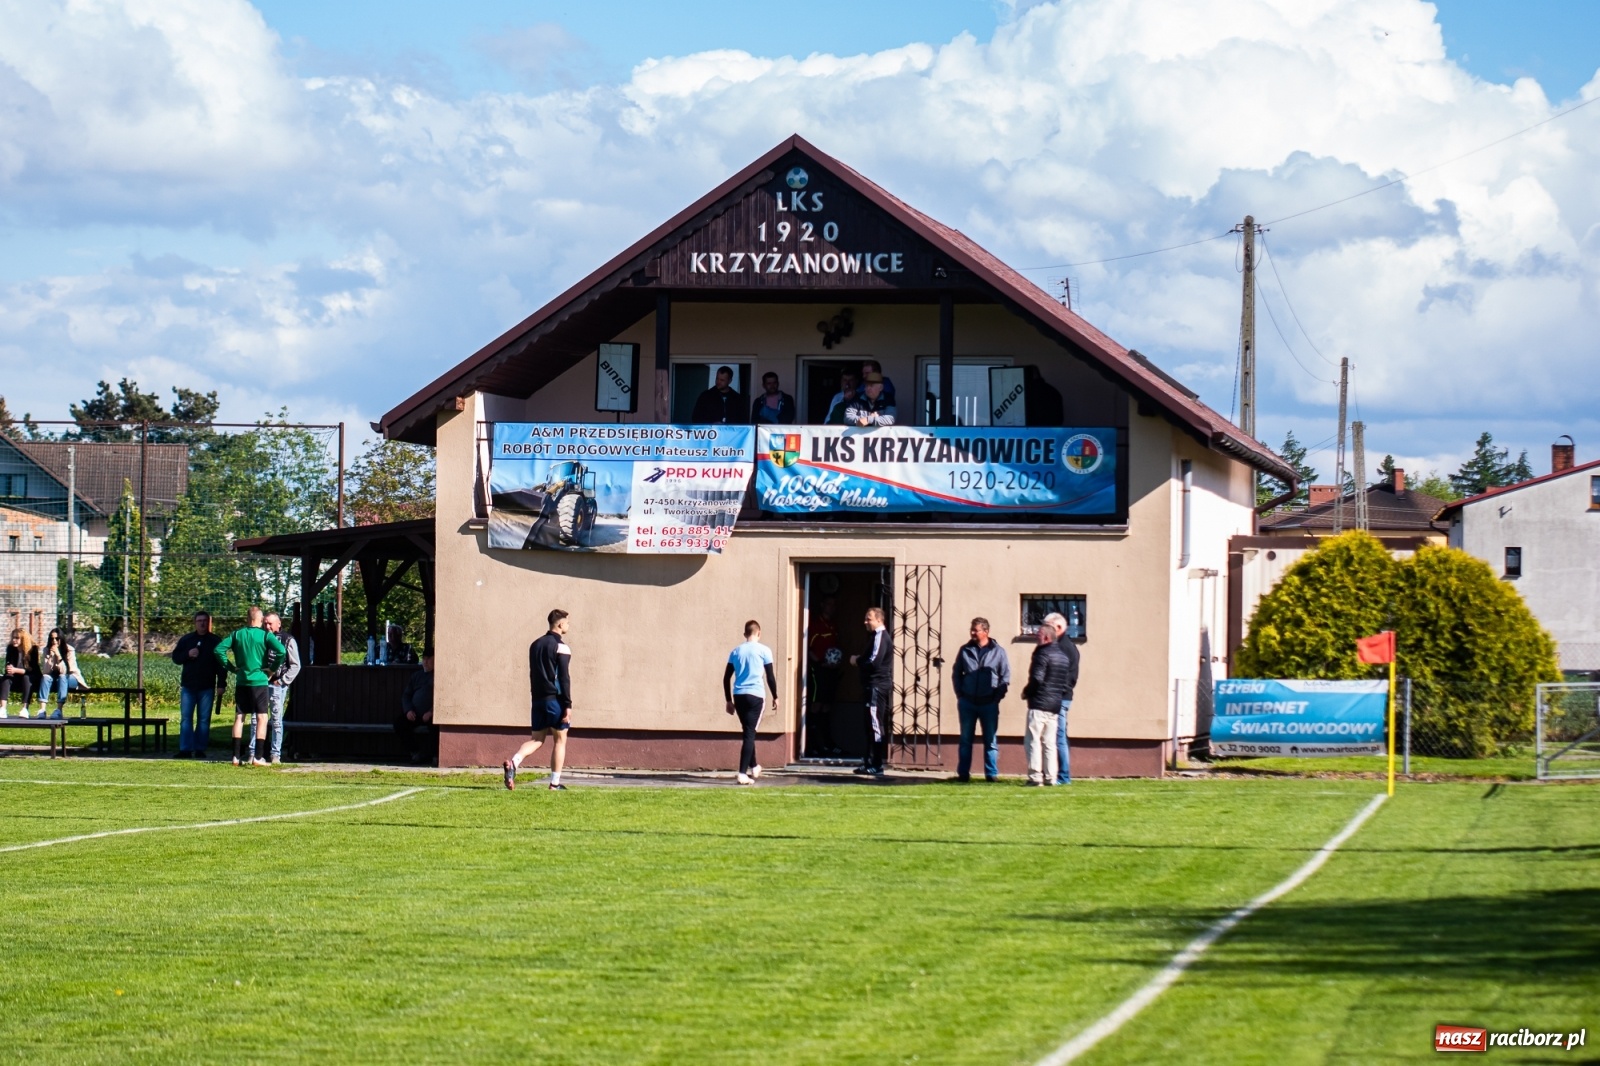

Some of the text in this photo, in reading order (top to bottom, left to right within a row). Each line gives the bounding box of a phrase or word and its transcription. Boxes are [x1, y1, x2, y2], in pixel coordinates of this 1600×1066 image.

[776, 191, 824, 212] LKS
[757, 221, 839, 243] 1920
[690, 247, 904, 274] KRZYŻANOWICE
[600, 360, 632, 394] BINGO
[993, 384, 1024, 420] BINGO
[531, 427, 717, 441] A&M PRZEDSIĘBIORSTWO
[503, 441, 552, 454] ROBÓT
[557, 444, 651, 455] DROGOWYCH
[655, 446, 708, 457] Mateusz
[811, 432, 1056, 464] LKS KRZYŻANOWICE
[666, 467, 744, 478] PRD KUHN
[948, 470, 1056, 490] 1920-2020
[643, 498, 675, 506] 47-450
[763, 486, 889, 512] Naszego Klubu
[637, 526, 733, 536] tel. 603 885 41
[635, 538, 655, 548] tel.
[660, 538, 682, 548] 663
[686, 538, 709, 548] 933
[1218, 683, 1266, 695] SZYBKI
[1225, 701, 1309, 715] INTERNET
[1230, 719, 1377, 735] ŚWIATŁOWODOWY
[1227, 744, 1281, 754] 32 700 9002
[1301, 745, 1380, 755] www.martcom.pl
